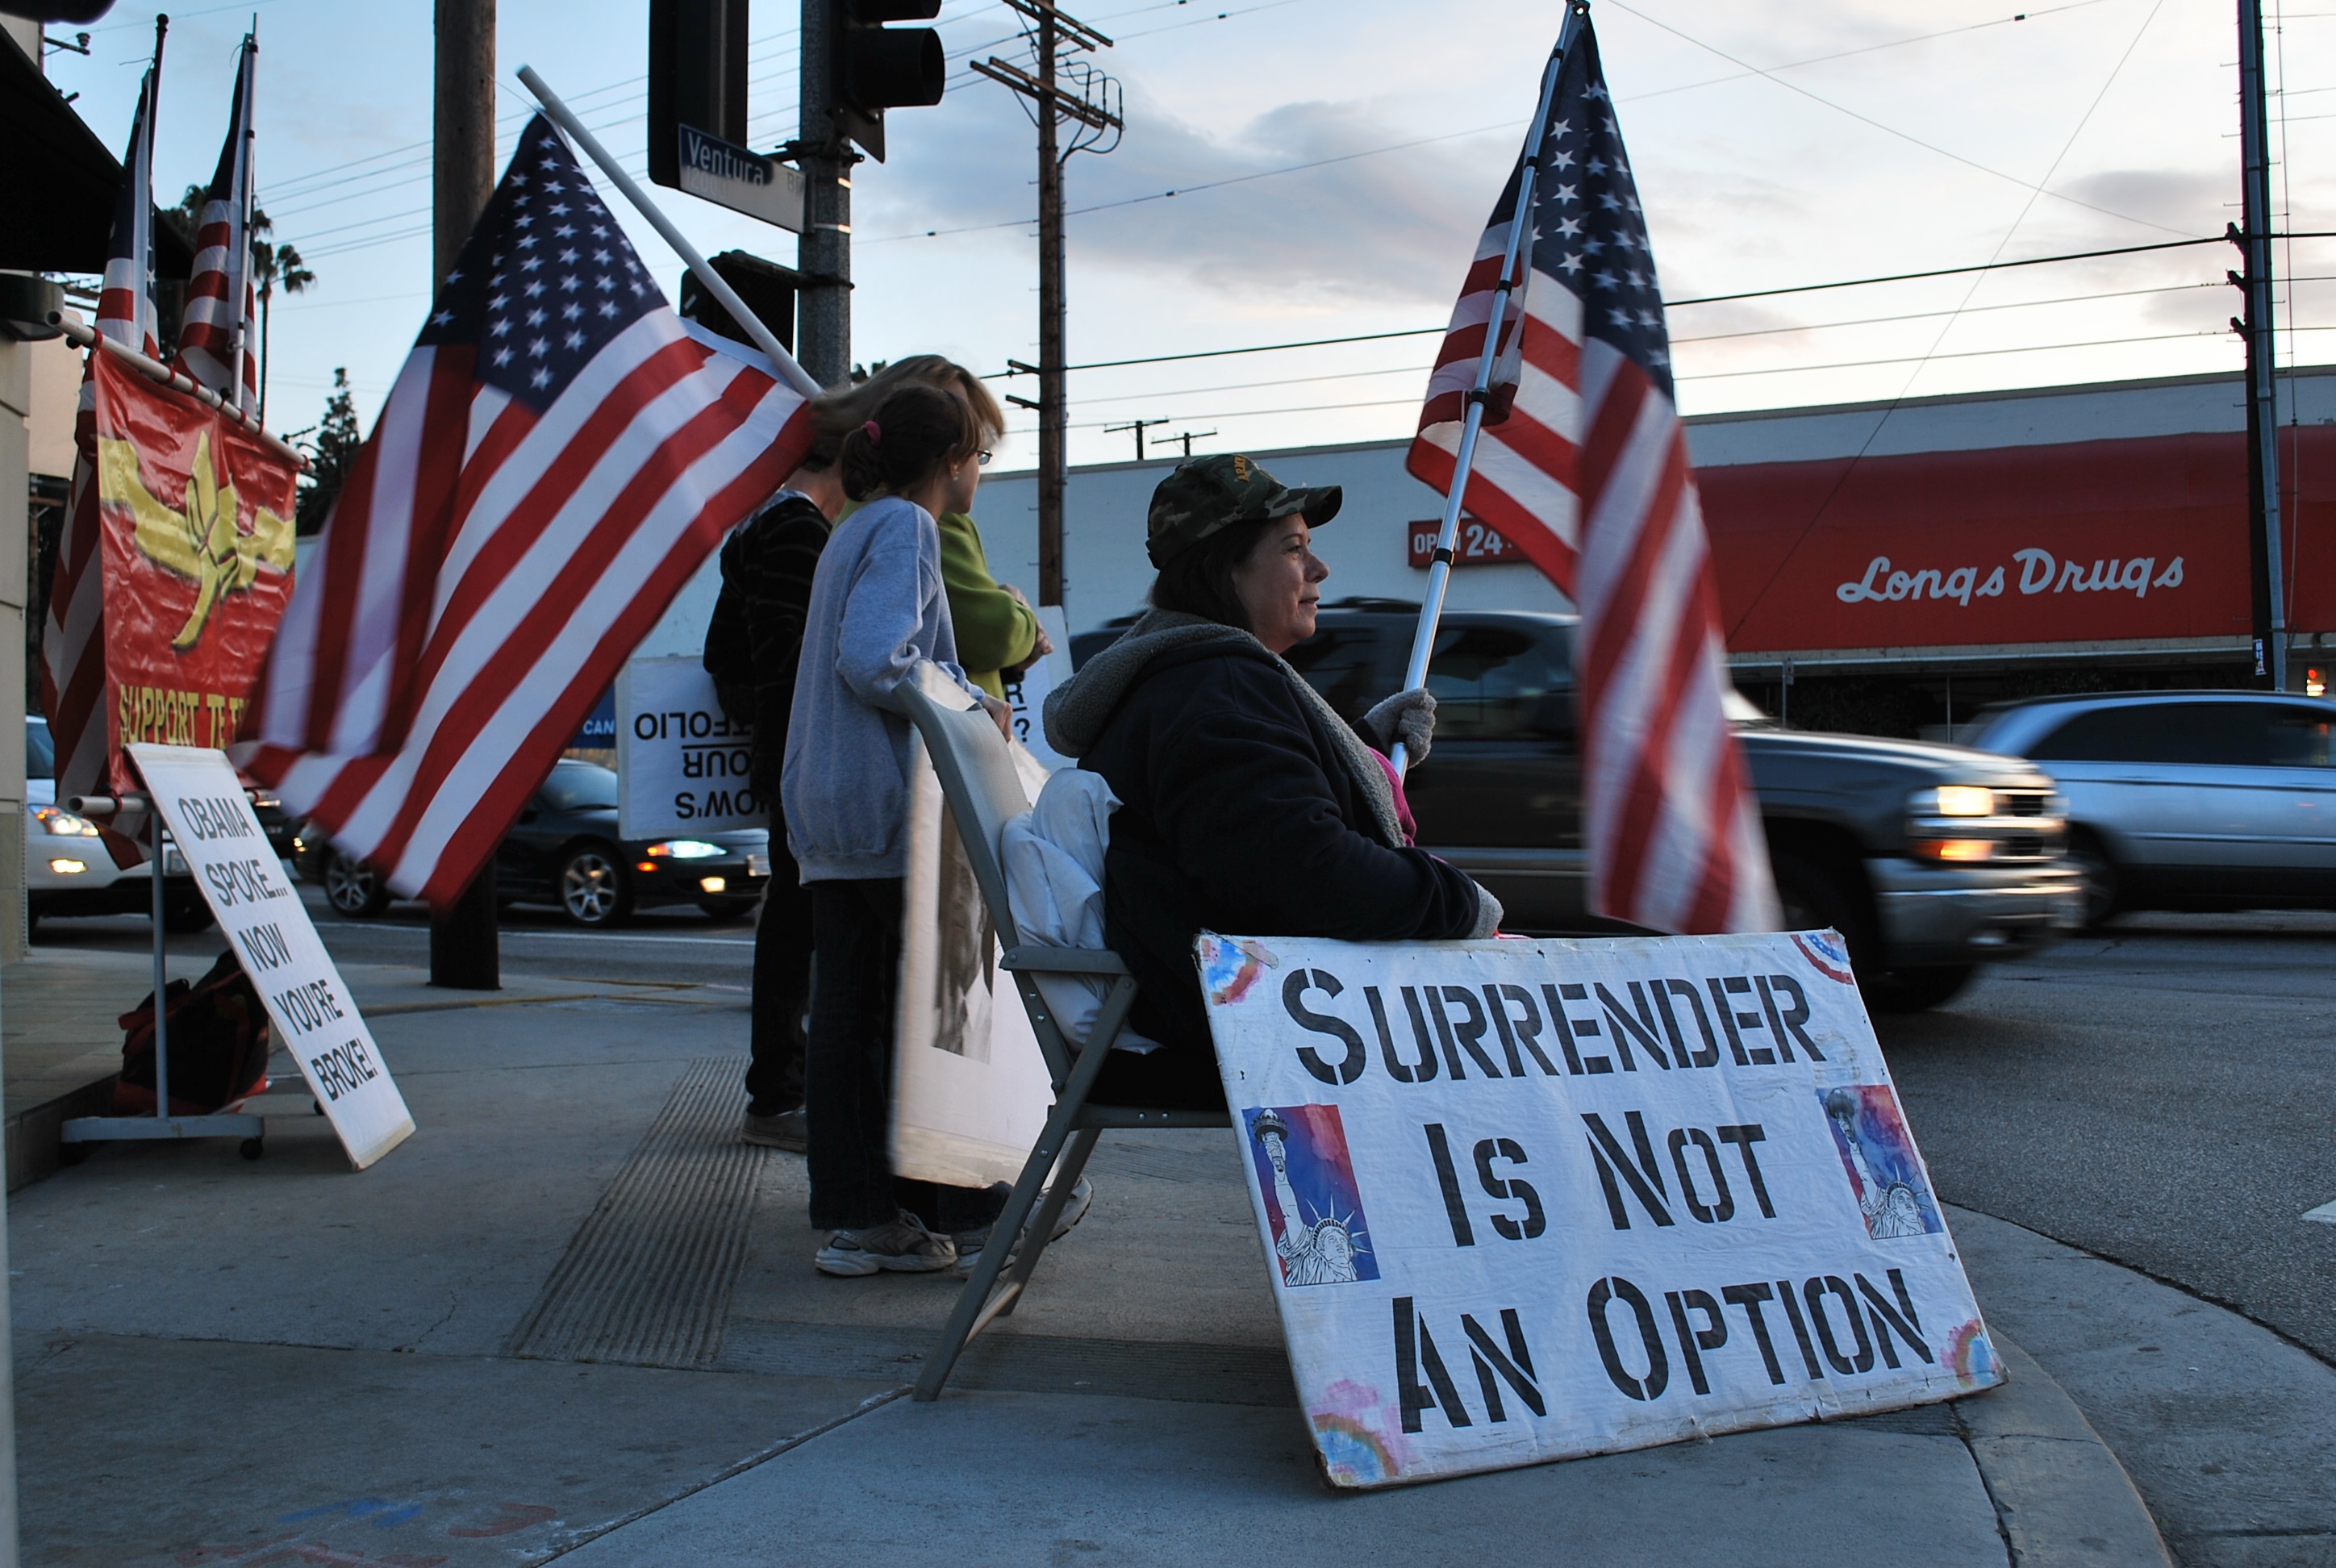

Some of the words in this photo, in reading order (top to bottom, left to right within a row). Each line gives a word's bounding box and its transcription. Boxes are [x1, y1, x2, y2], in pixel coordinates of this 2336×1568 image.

[688, 130, 765, 186] Ventura
[1414, 532, 1461, 554] OPN
[1466, 524, 1503, 557] 24
[1836, 556, 2005, 607] Longs
[2013, 547, 2184, 598] Drugs
[119, 684, 200, 749] SUPPORT
[683, 749, 752, 778] OUR
[178, 797, 255, 840] OBAMA
[675, 789, 765, 819] OW'S
[206, 859, 289, 907] SPOKE...
[238, 923, 293, 973] NOW
[273, 978, 344, 1036] YOU'RE
[1282, 967, 1828, 1086] SURRENDER
[311, 1037, 379, 1102] BROKE!
[1423, 1122, 1546, 1248] IS
[1579, 1110, 1778, 1231] NOT
[1391, 1295, 1548, 1434] AN
[1587, 1269, 1935, 1402] OPTION
